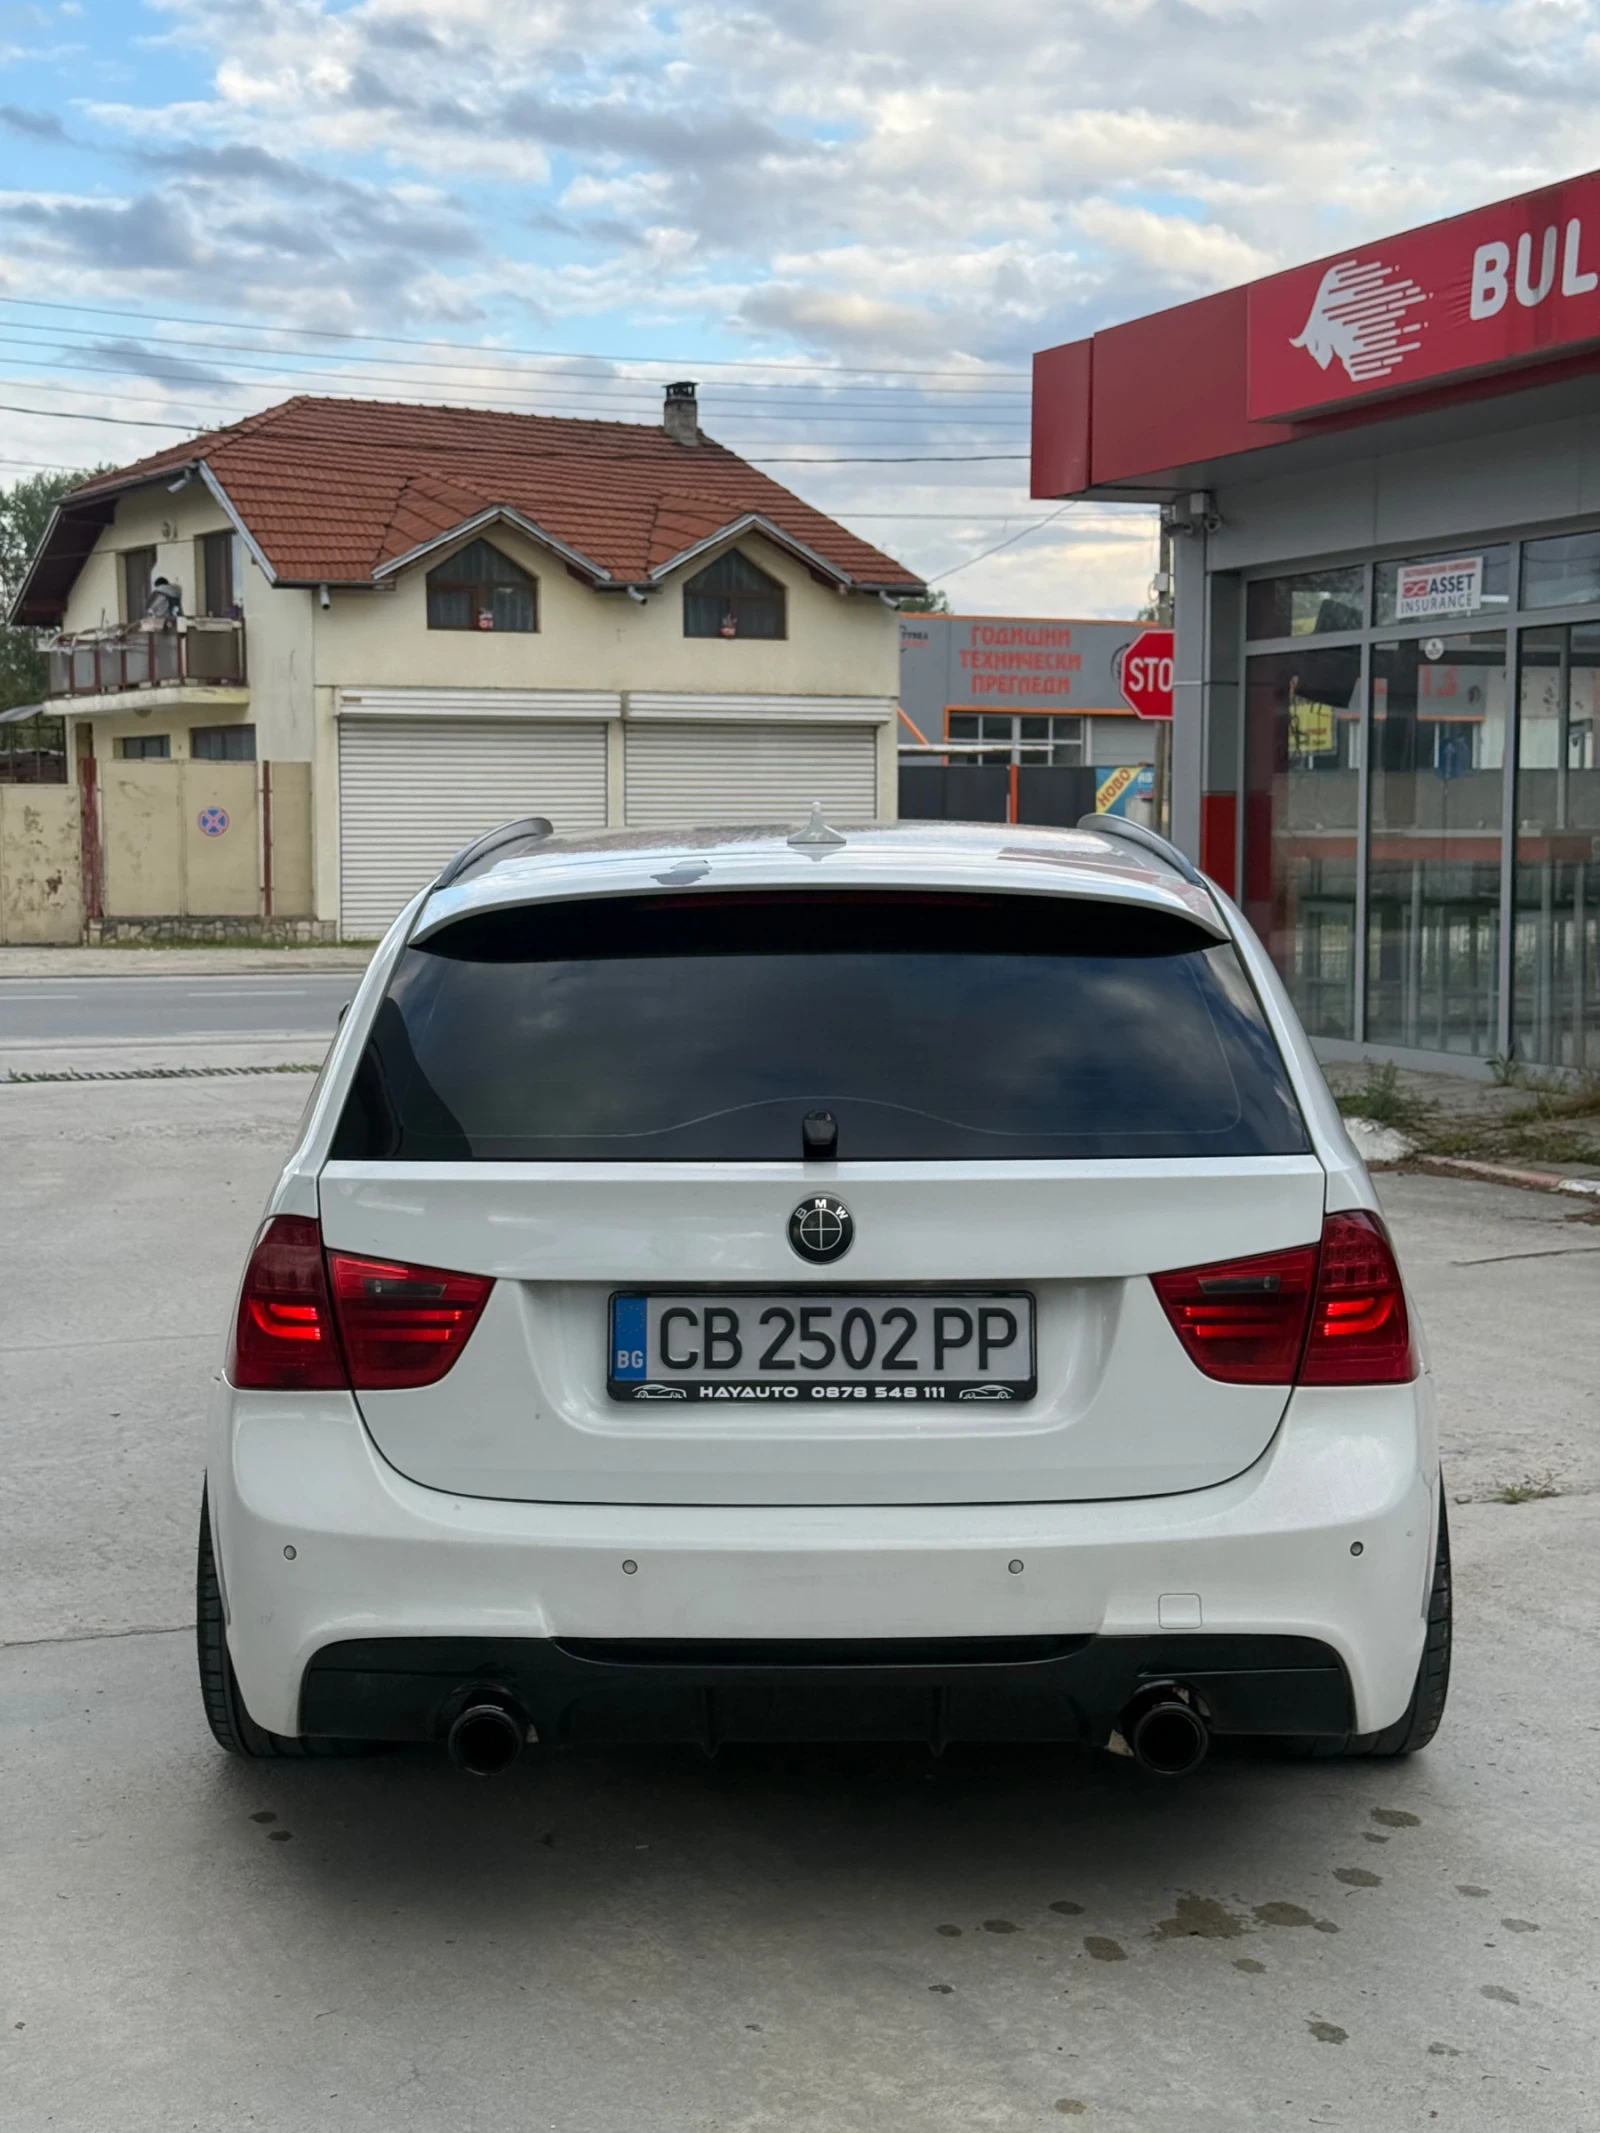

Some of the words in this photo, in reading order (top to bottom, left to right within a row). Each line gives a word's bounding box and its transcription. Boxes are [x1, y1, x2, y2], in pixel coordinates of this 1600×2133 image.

[1470, 217, 1598, 320] BUL
[1430, 573, 1474, 594] ASSET
[1401, 593, 1472, 614] INSURANCE
[971, 626, 1071, 647] ГОДИШНИ
[959, 648, 1082, 671] ТЕХНИЧЕСКИ
[971, 674, 1070, 695] ПРЕГЛЕДИ
[1128, 656, 1174, 692] STO
[1097, 769, 1131, 808] НОВО
[794, 1198, 849, 1220] BMW
[659, 1306, 742, 1370] CB
[759, 1306, 918, 1370] 2502
[933, 1306, 1018, 1370] PP
[616, 1350, 644, 1369] BG
[699, 1386, 799, 1398] HAYAUTO
[811, 1386, 867, 1398] 0878
[875, 1386, 917, 1398] 548
[923, 1386, 946, 1398] 111
